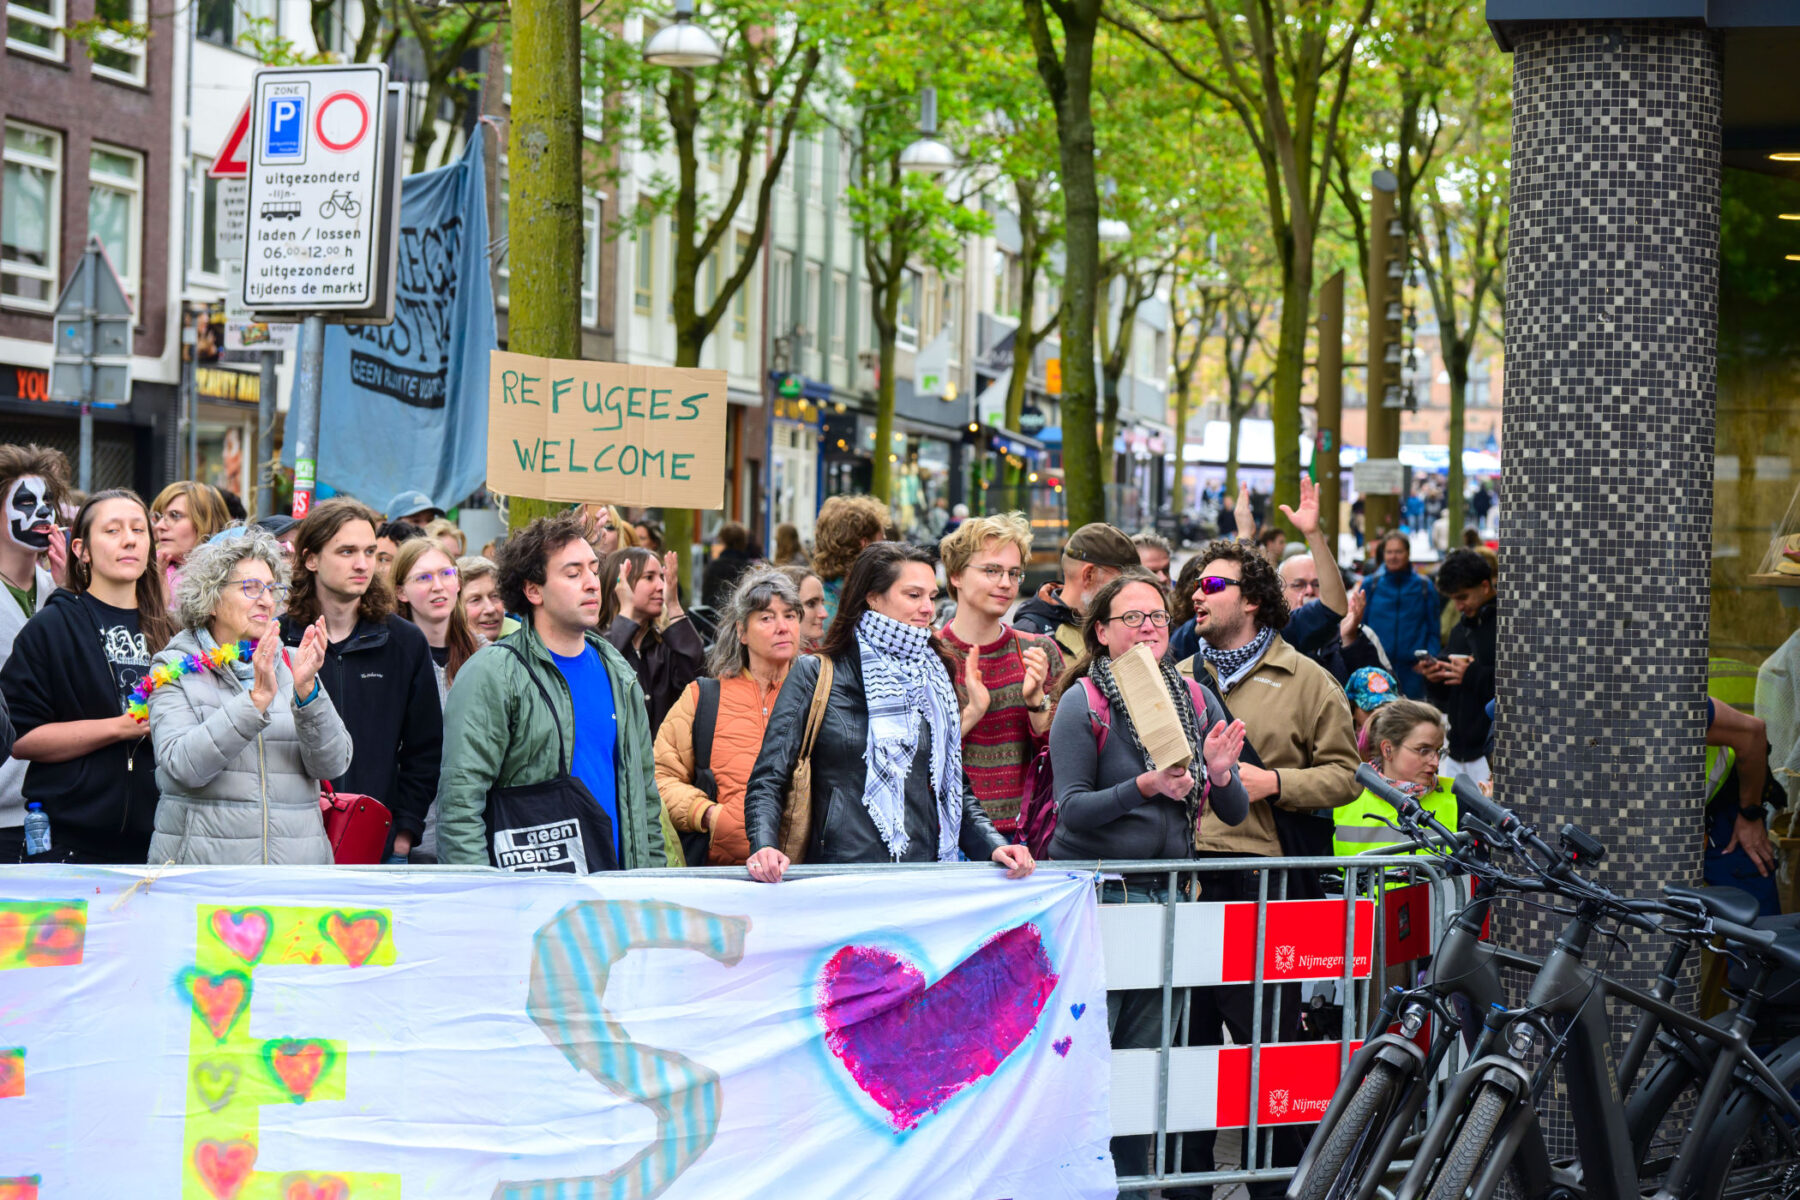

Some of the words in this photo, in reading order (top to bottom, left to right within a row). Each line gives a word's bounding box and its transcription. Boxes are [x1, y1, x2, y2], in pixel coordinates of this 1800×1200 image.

[273, 86, 300, 95] ZONE
[274, 101, 296, 132] P
[265, 170, 360, 187] uitgezonderd
[258, 229, 296, 241] laden
[316, 228, 361, 240] lossen
[345, 246, 353, 257] h
[261, 264, 355, 280] uitgezonderd
[250, 283, 297, 298] tijdens
[301, 283, 317, 294] de
[322, 281, 363, 294] markt
[352, 358, 383, 387] GEEN
[502, 370, 709, 431] REFUGEES
[513, 438, 695, 480] WELCOME
[527, 825, 573, 846] geen
[502, 846, 561, 866] mens
[1299, 955, 1344, 970] Nijmegen
